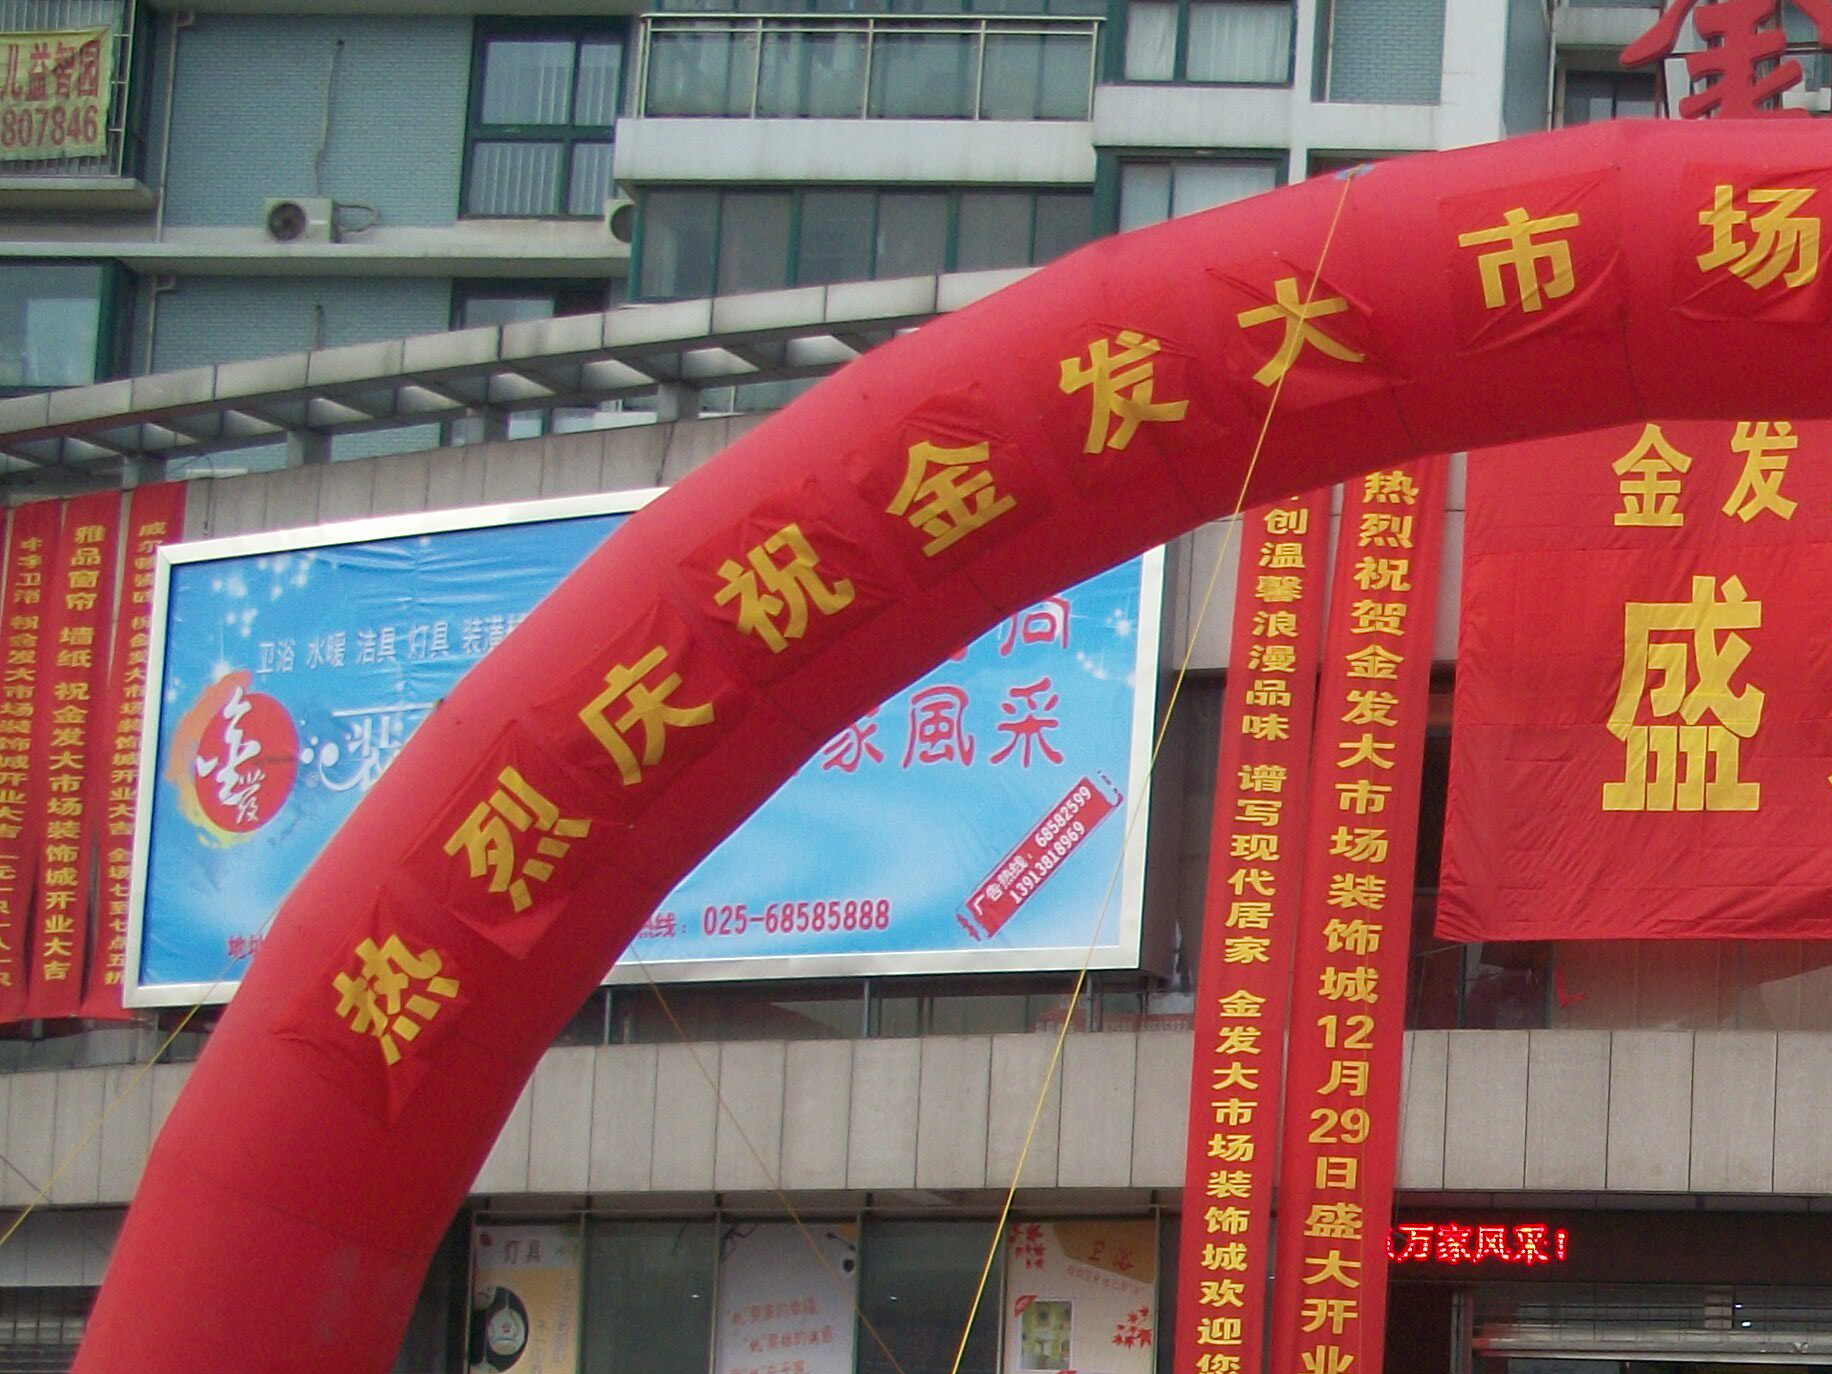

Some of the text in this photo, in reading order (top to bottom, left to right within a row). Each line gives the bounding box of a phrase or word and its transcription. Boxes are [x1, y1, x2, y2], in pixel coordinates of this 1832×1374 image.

[1, 104, 98, 149] 807846
[57, 626, 95, 669] 墙纸
[257, 612, 527, 676] 卫浴 水暖 洁具 灯具 装潢
[1241, 498, 1310, 741] 创温馨浪漫品味
[1034, 785, 1092, 848] 68582599
[1009, 820, 1086, 905] 13913818969
[1224, 764, 1288, 964] 谱写现代居家
[702, 898, 891, 937] 025-68585888
[1386, 1221, 1569, 1266] 万家风采！
